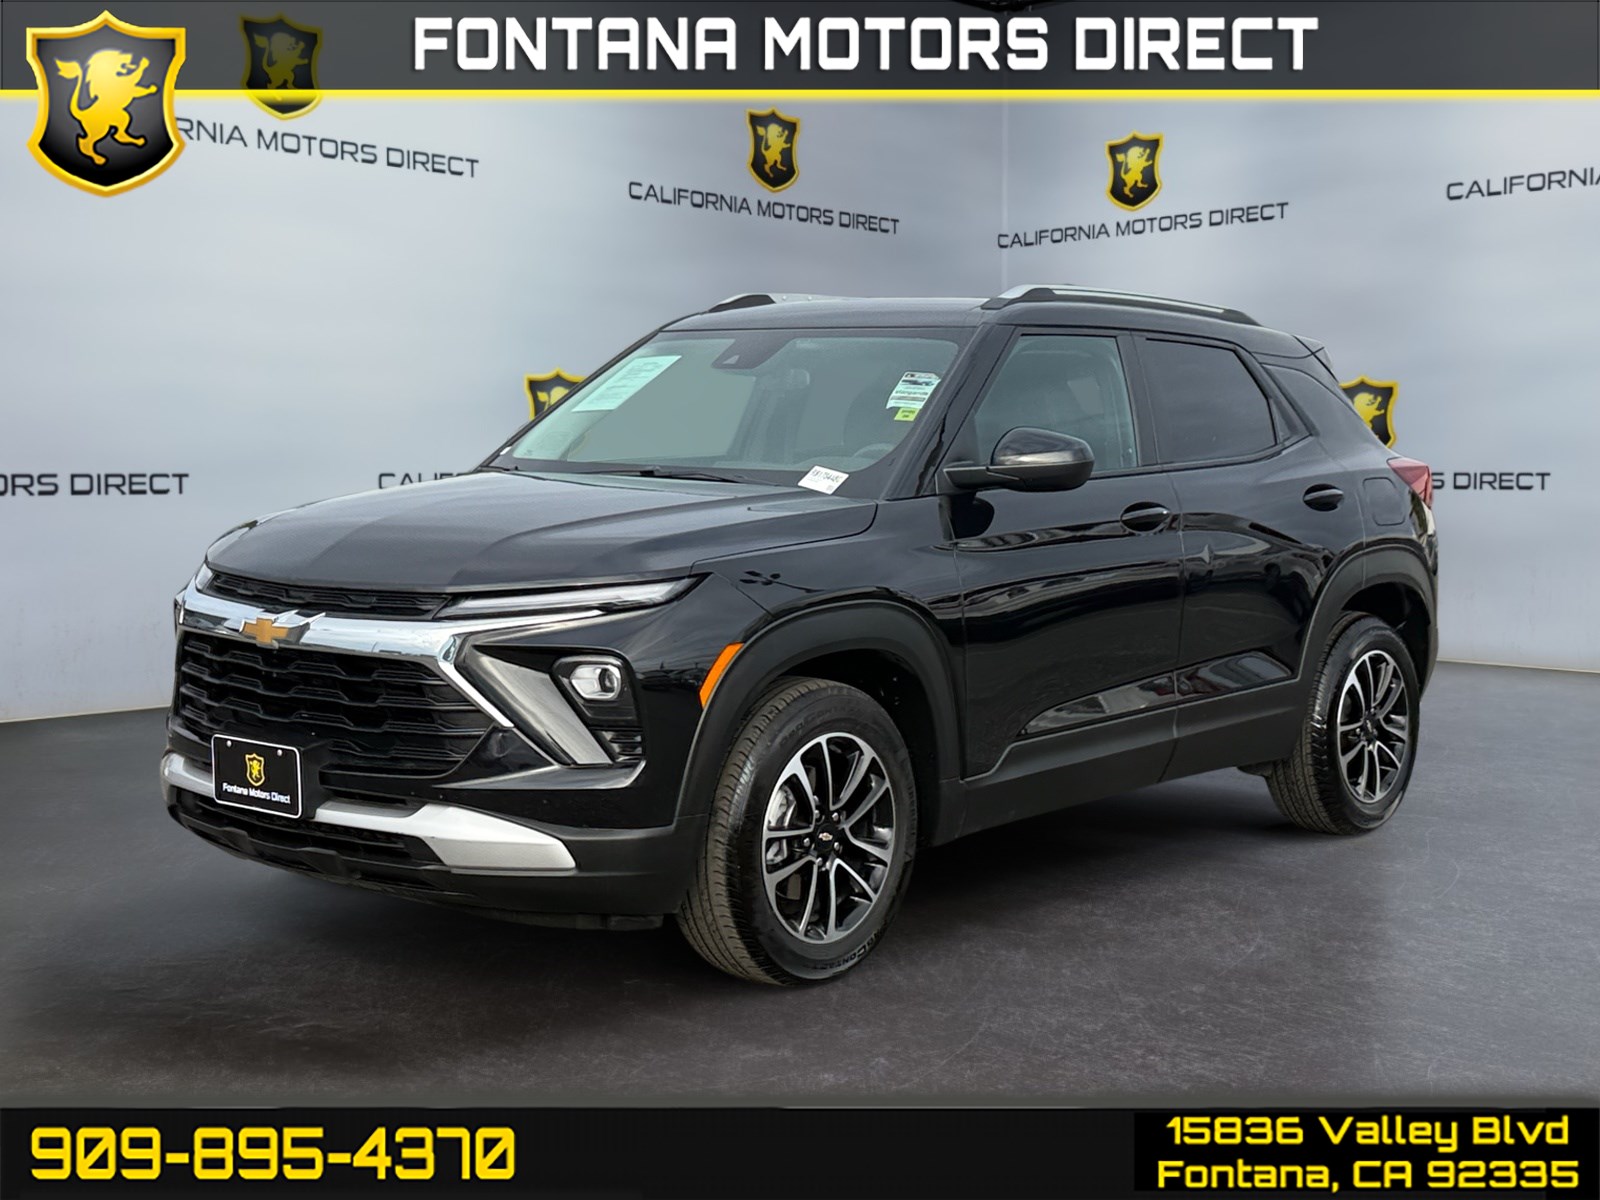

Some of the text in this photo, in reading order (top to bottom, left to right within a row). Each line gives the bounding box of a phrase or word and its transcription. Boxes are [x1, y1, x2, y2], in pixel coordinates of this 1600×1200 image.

[175, 117, 479, 178] RNIA MOTORS DIRECT
[1446, 167, 1600, 201] CALIFORNI
[628, 181, 900, 235] CALIFORNIA MOTORS DIRECT
[997, 202, 1289, 249] CALIFORNIA MOTORS DIRECT
[70, 473, 190, 496] DIRECT
[1452, 472, 1552, 491] DIRECT
[222, 782, 291, 805] Fontana Motors Direct
